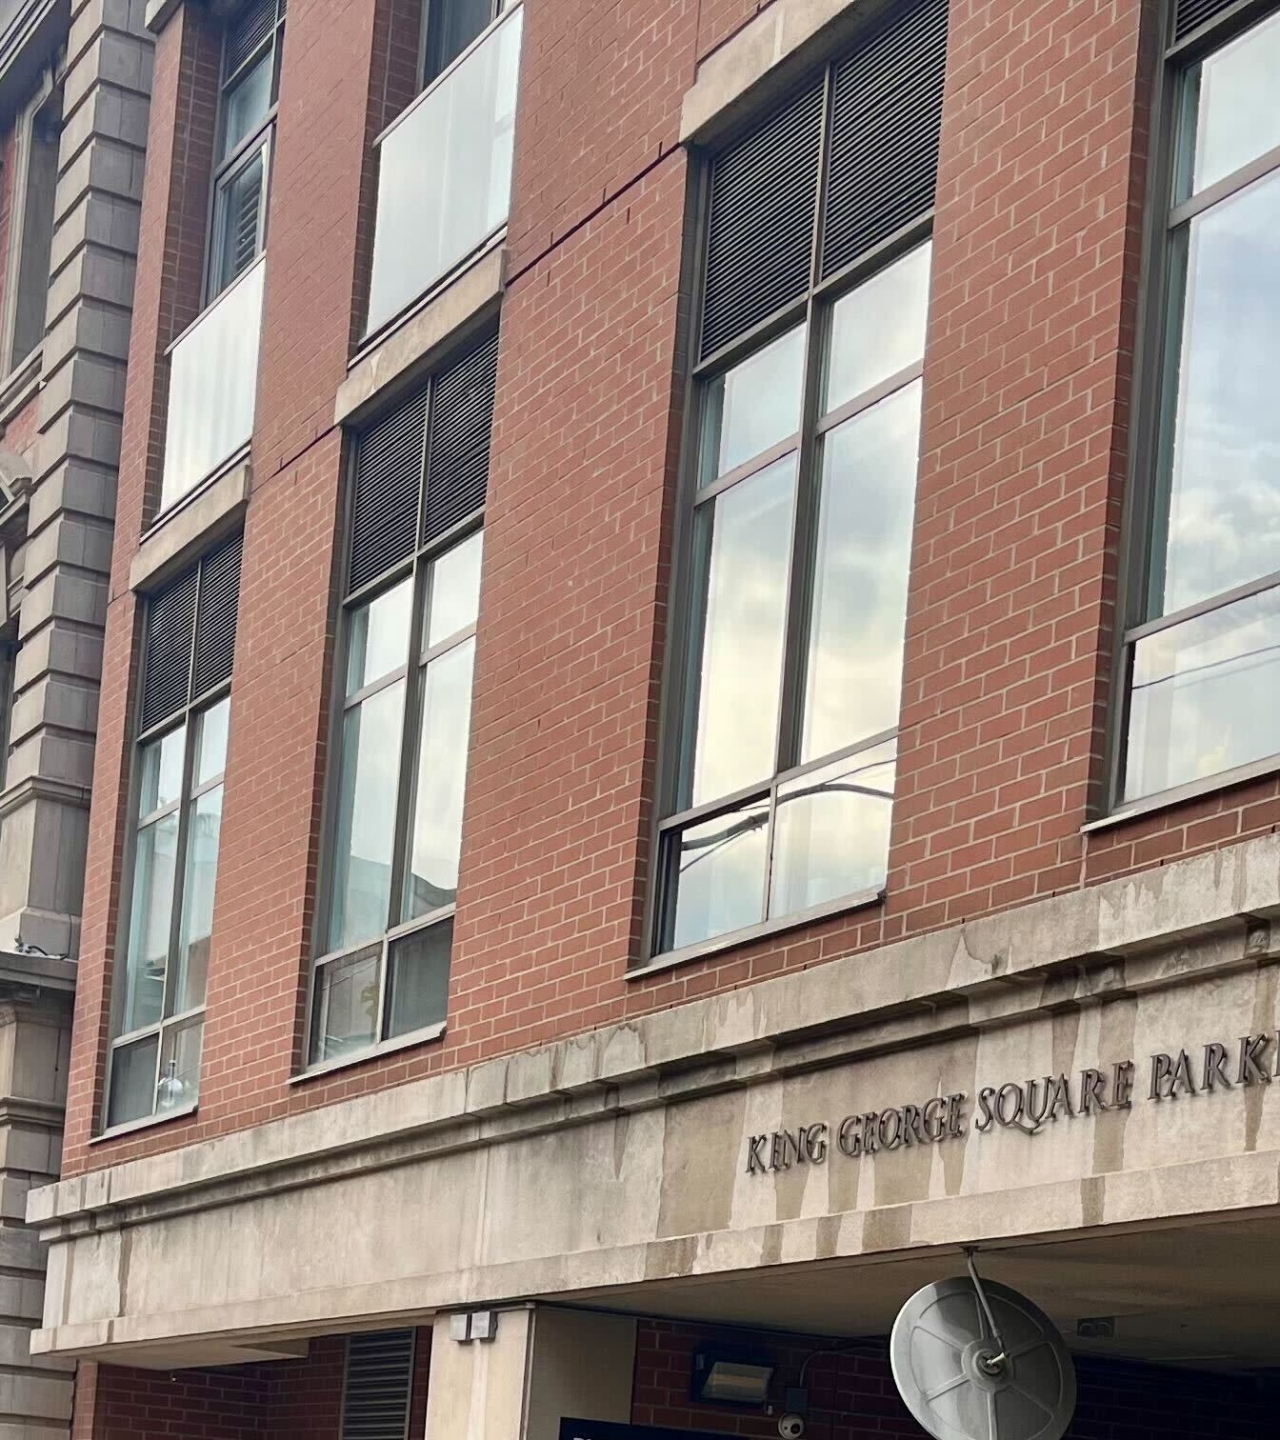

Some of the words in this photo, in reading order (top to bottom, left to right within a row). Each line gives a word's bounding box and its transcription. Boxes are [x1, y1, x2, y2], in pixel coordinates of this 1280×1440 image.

[746, 1122, 828, 1174] KING
[837, 1093, 966, 1158] GEORGE
[975, 1060, 1134, 1135] SQUARE
